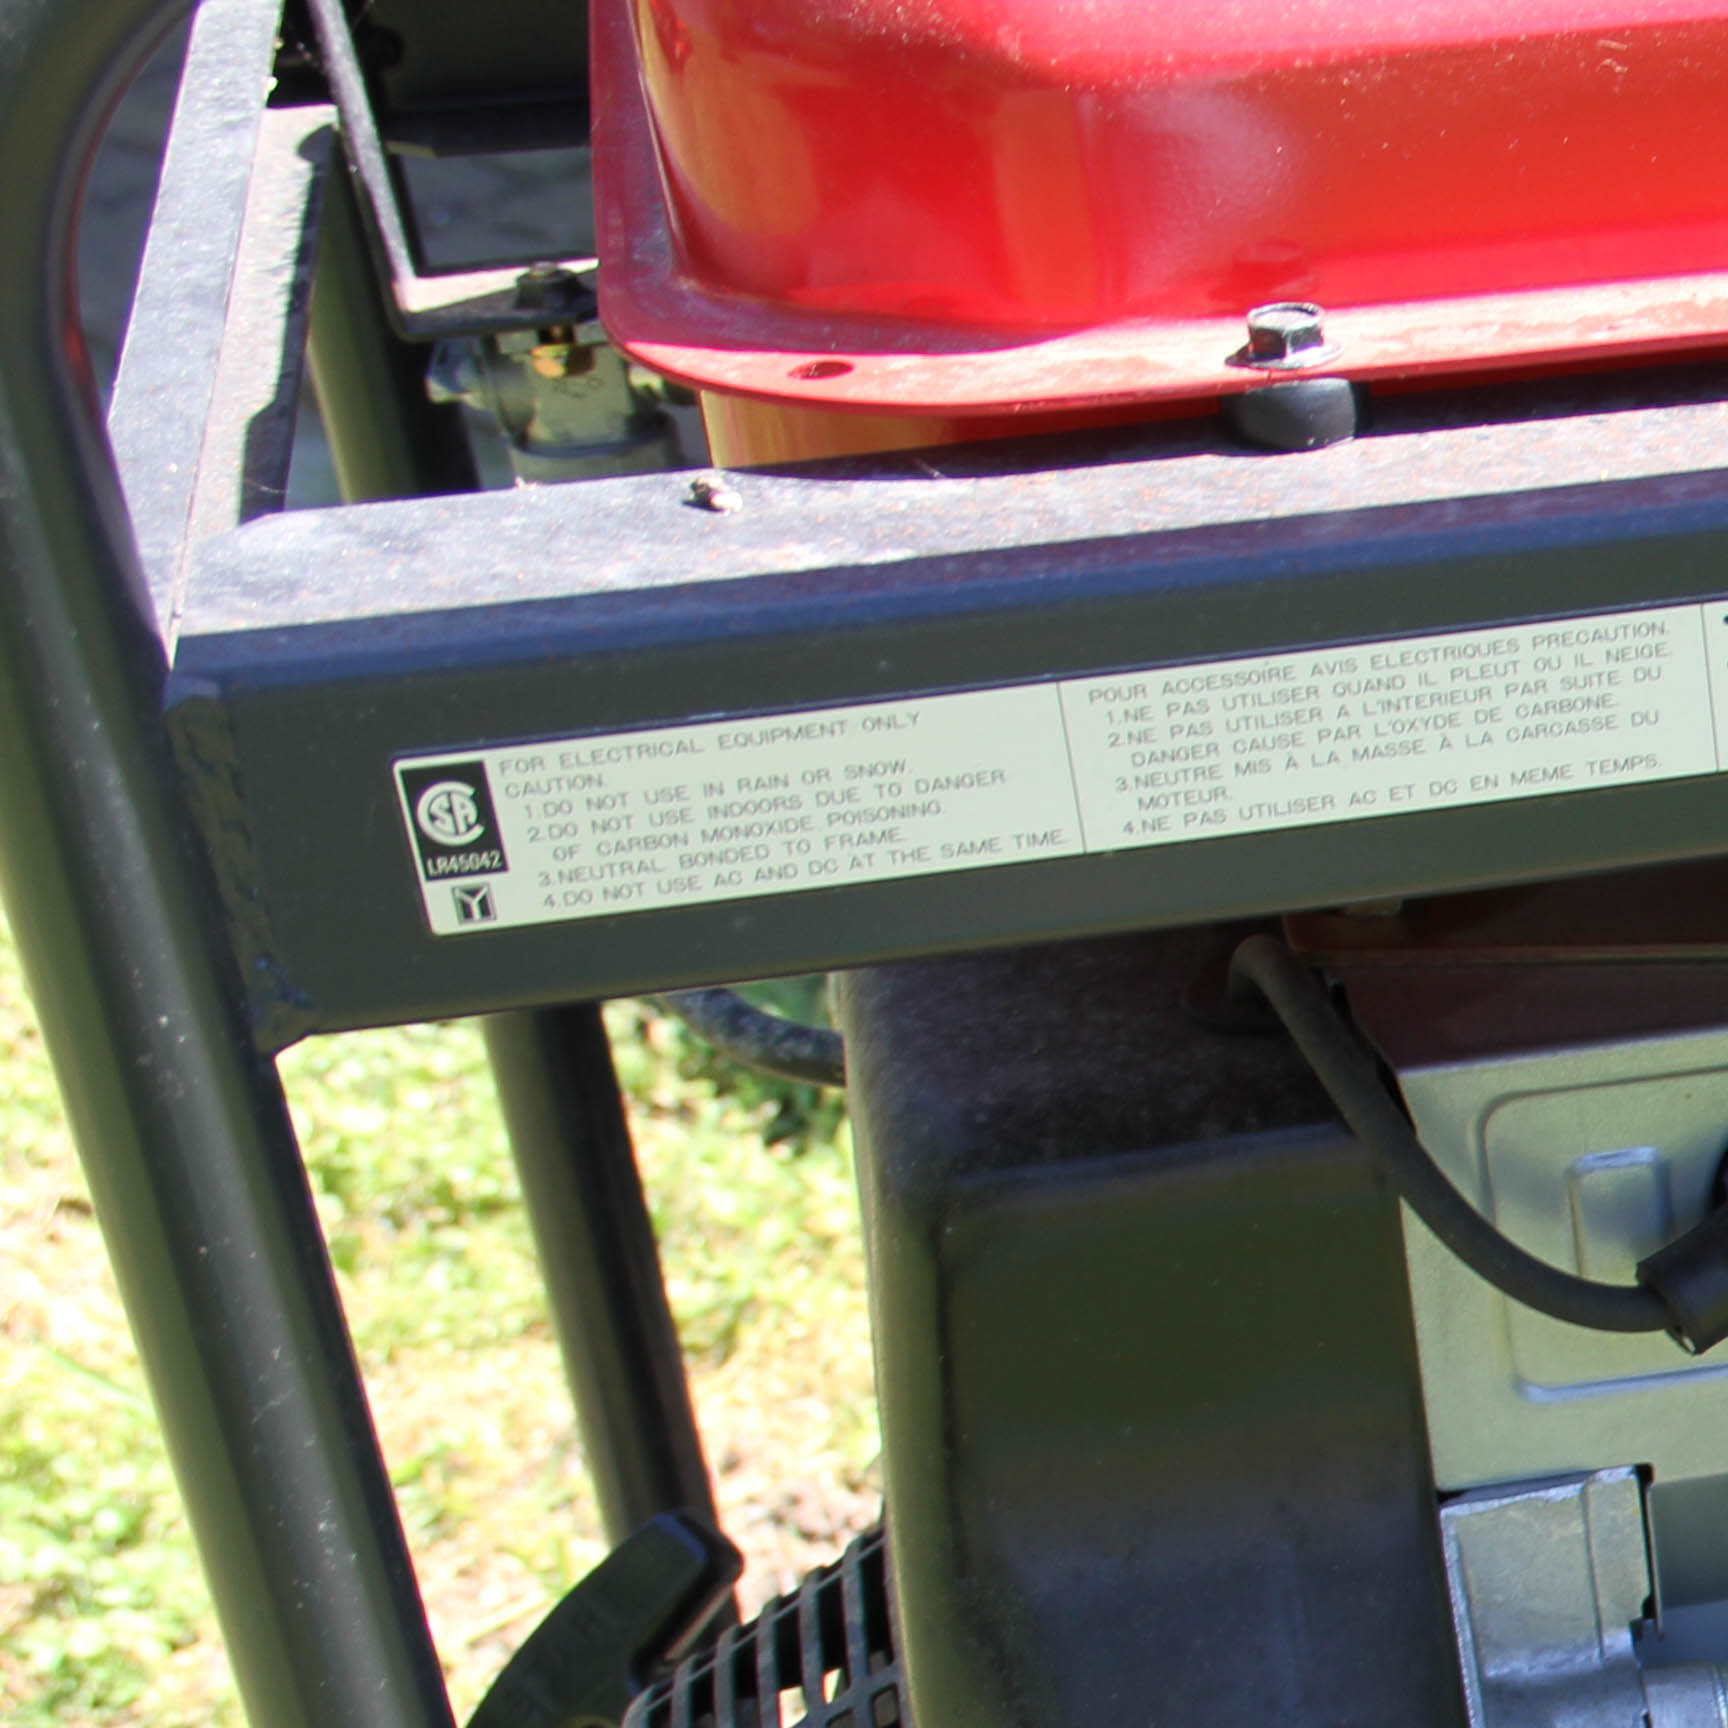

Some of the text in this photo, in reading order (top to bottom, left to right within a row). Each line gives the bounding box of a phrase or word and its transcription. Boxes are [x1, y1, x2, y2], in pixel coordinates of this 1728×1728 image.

[1088, 683, 1147, 703] POUR
[1310, 657, 1358, 677] AVIS
[1370, 637, 1519, 670] ELECTRIQUES
[1165, 697, 1210, 718] PAS
[1221, 684, 1319, 711] UTILISER
[1332, 673, 1406, 698] QUAND
[1417, 671, 1438, 687] IL
[1449, 659, 1520, 682] PLEUT
[1532, 654, 1562, 673] OU
[1573, 651, 1594, 668] IL
[1169, 720, 1213, 740] PAS
[1225, 706, 1323, 733] UTILISER
[1503, 678, 1548, 698] PAR
[1559, 669, 1621, 691] SUITE
[1632, 665, 1661, 683] DU
[497, 711, 919, 777] FOR ELECTRICAL EQUIPMENT ONLY
[1130, 741, 1219, 767] DANGER
[1232, 730, 1305, 754] CAUSE
[1316, 724, 1361, 743] PAR
[1473, 705, 1502, 725] DE
[1233, 757, 1271, 776] MIS
[1284, 751, 1299, 771] À
[1310, 749, 1340, 767] LA
[1351, 738, 1426, 761] MASSE
[1438, 732, 1453, 752] À
[1464, 730, 1494, 748] LA
[1505, 714, 1617, 742] CARCASSE
[1630, 709, 1659, 727] DU
[585, 791, 628, 812] NOT
[643, 784, 689, 805] USE
[702, 781, 724, 798] IN
[736, 773, 789, 793] RAIN
[800, 767, 831, 786] OR
[590, 813, 633, 835] NOT
[648, 806, 694, 827] USE
[706, 794, 802, 819] INDOORS
[814, 786, 861, 807] DUE
[872, 781, 902, 799] TO
[914, 769, 1004, 795] DANGER
[1137, 785, 1231, 810] MOTEUR.
[1182, 808, 1227, 828] PAS
[1238, 794, 1335, 820] UTILISER
[1347, 789, 1376, 807] AC
[1388, 783, 1415, 802] ET
[1428, 778, 1457, 797] DC
[1469, 773, 1499, 792] EN
[1509, 763, 1573, 786] MEME
[1585, 753, 1661, 776] TEMPS.
[552, 843, 581, 861] OF
[595, 831, 688, 856] CARBON
[700, 815, 814, 843] MONOXIDE
[601, 881, 645, 901] NOT
[656, 874, 702, 895] USE
[713, 869, 743, 887] AC
[753, 862, 798, 882] AND
[807, 857, 839, 877] DC
[847, 851, 875, 871] AT
[885, 845, 930, 865] THE
[940, 836, 1002, 858] SAME
[678, 843, 770, 870] BONDED
[780, 838, 811, 856] TO
